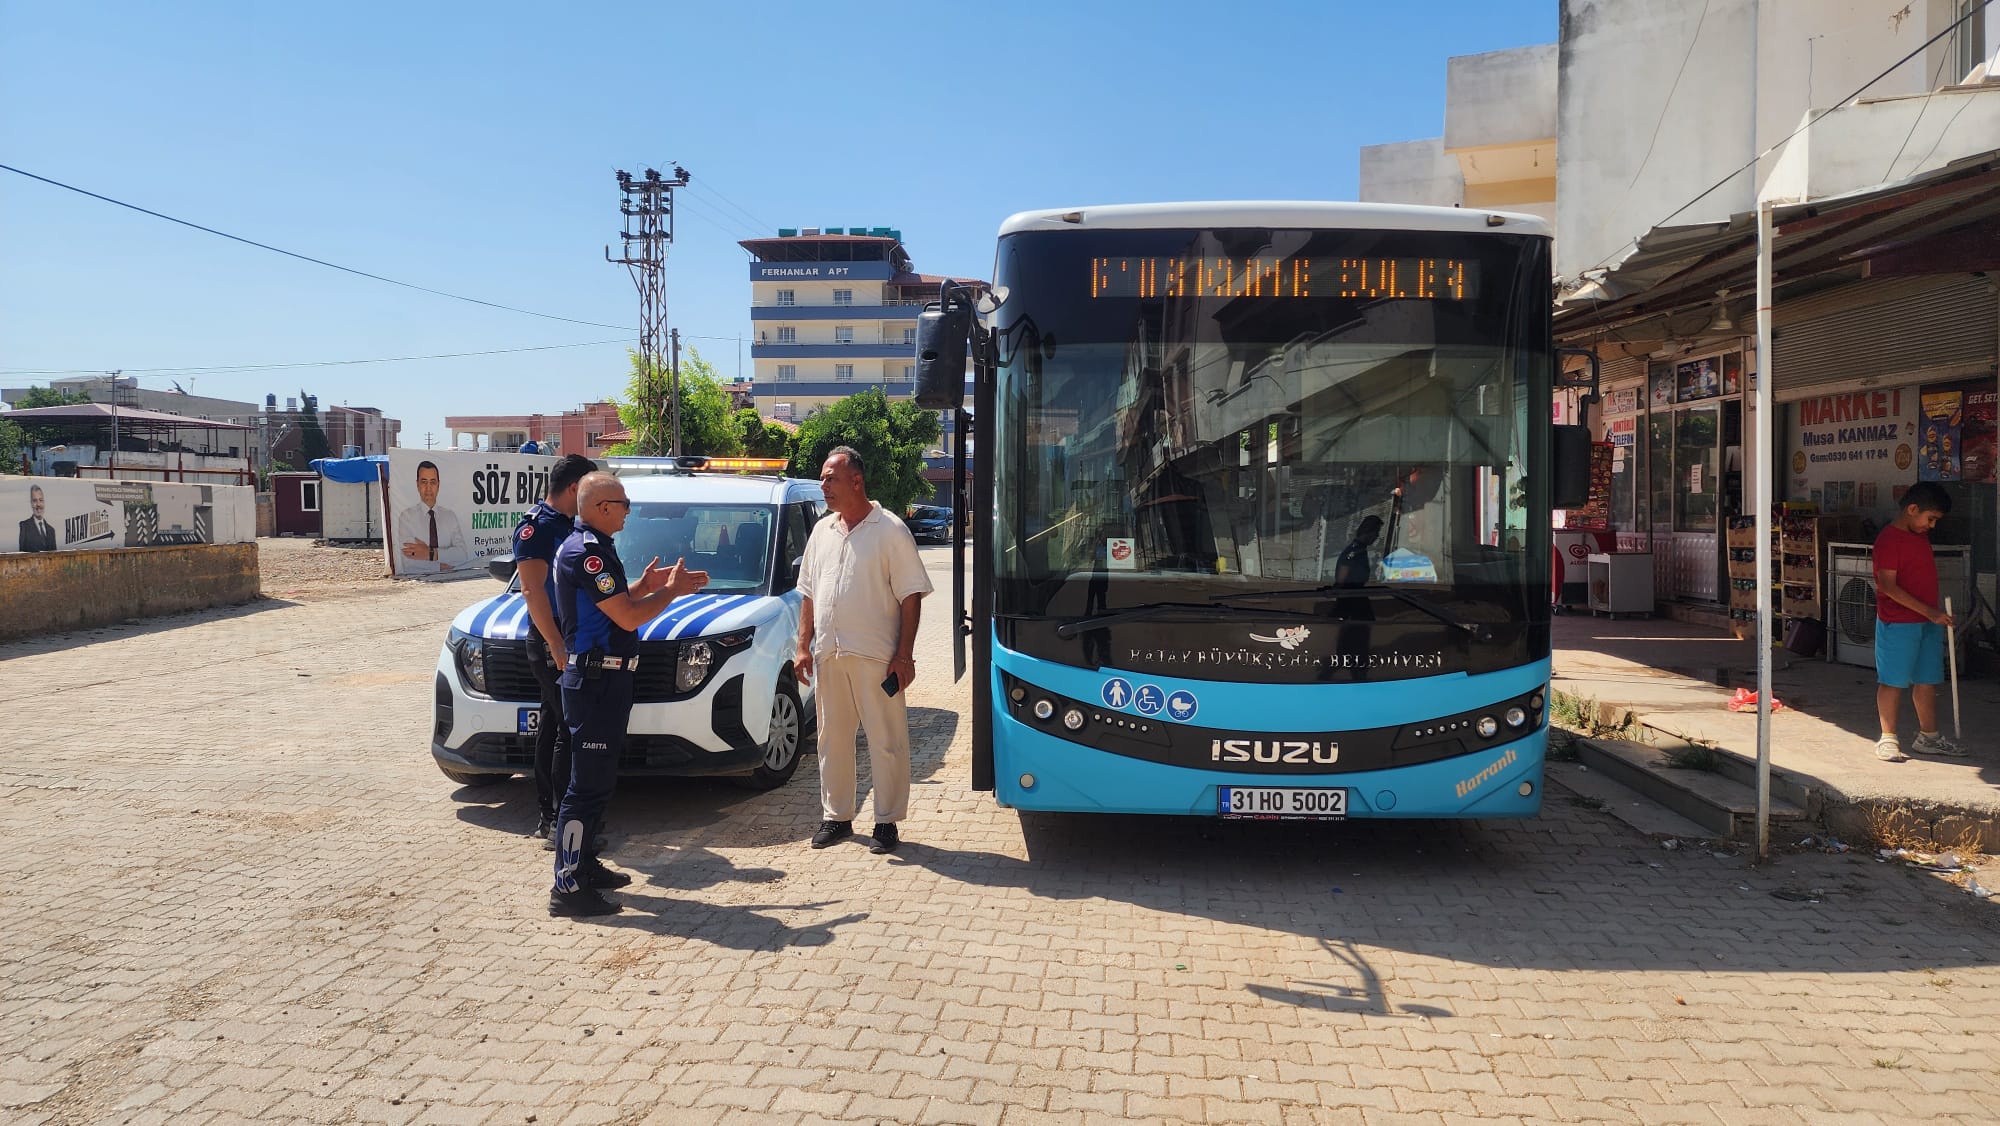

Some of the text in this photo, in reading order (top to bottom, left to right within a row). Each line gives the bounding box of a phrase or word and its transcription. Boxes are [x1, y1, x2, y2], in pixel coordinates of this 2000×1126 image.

[761, 267, 849, 276] FERHANLAR APT
[1614, 433, 1634, 446] TELEFON
[1803, 424, 1897, 447] Musa KANMAZ
[472, 464, 511, 505] SÖZ
[65, 513, 89, 545] HATAY
[472, 510, 508, 530] HİZMET
[486, 547, 513, 556] Minibüs
[1130, 649, 1191, 664] HATAY
[582, 742, 608, 750] ZABITA
[1212, 739, 1339, 764] ISUZU
[1232, 791, 1254, 811] 31
[1260, 791, 1284, 811] HO
[1292, 792, 1342, 812] 5002
